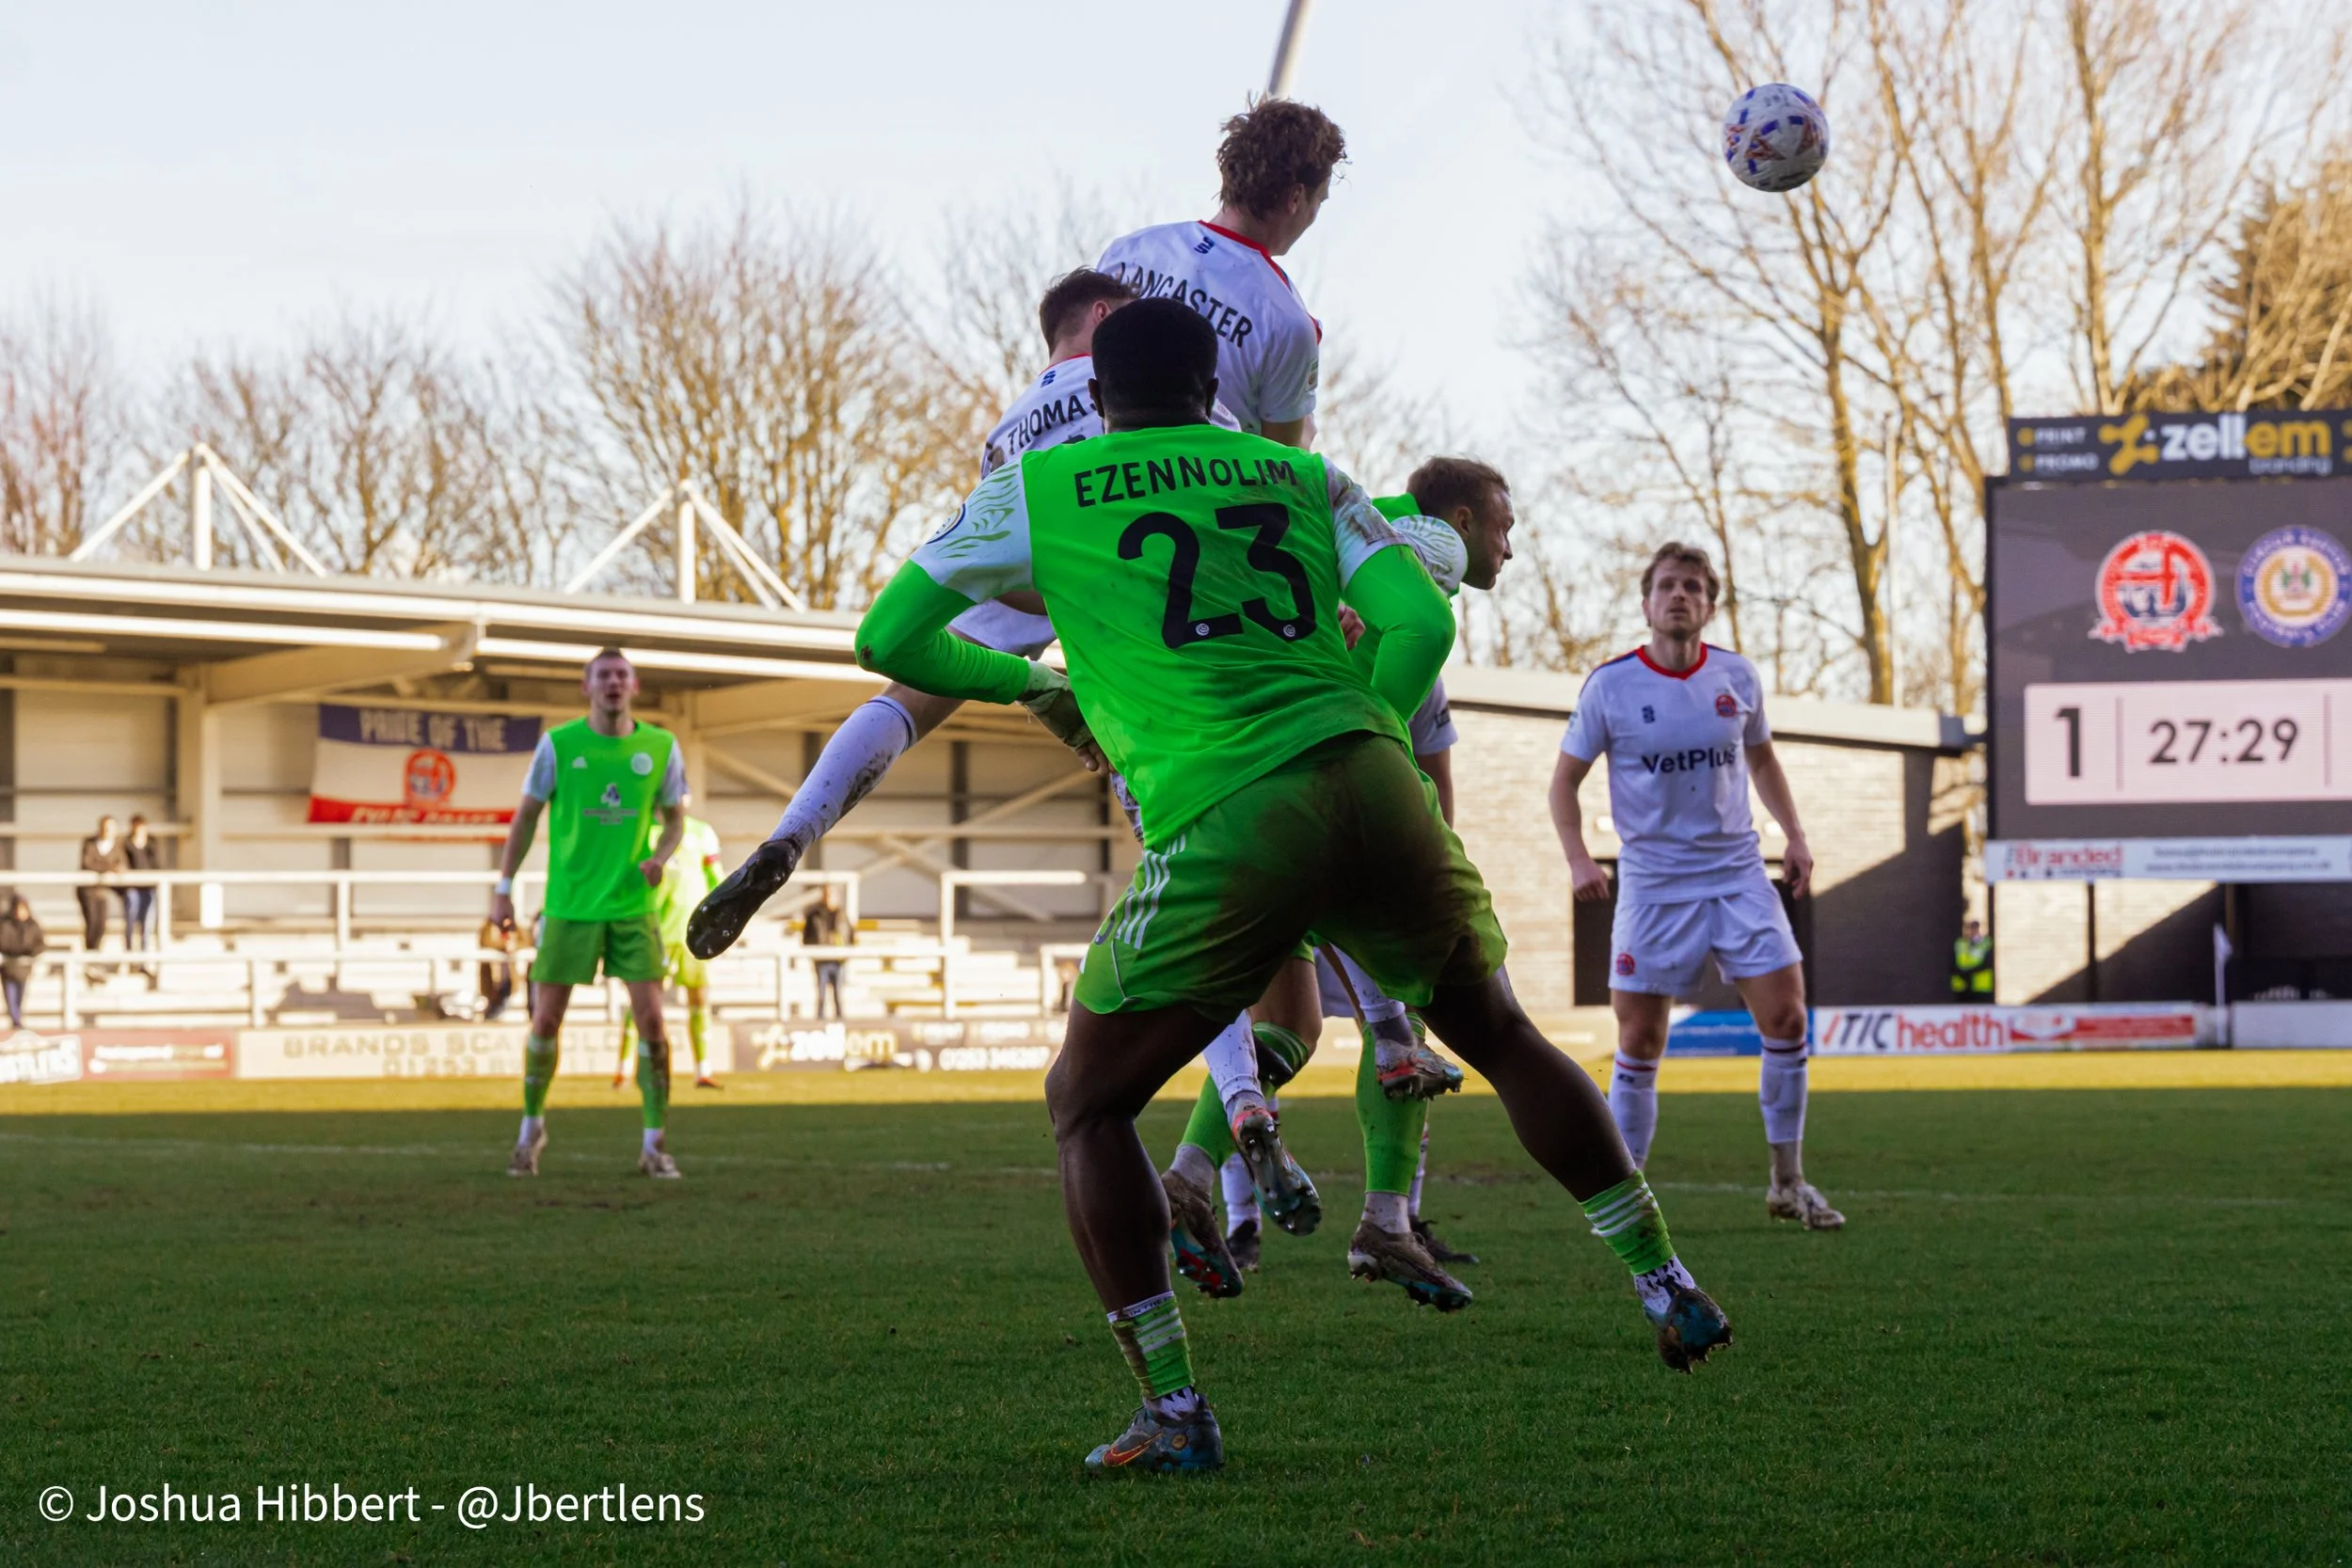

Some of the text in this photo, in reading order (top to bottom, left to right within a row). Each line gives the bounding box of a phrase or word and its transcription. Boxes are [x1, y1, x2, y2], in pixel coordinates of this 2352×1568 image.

[1118, 261, 1253, 349] LANCASTER
[2035, 452, 2100, 470] PROMO
[2160, 414, 2332, 461] zellem
[1074, 456, 1298, 508] EZENNOLIM
[1118, 502, 1316, 649] 23
[359, 709, 508, 752] PRIDE OF THE
[2055, 707, 2082, 778] 1
[2148, 719, 2300, 765] 27:29
[1641, 743, 1737, 775] VetPlus
